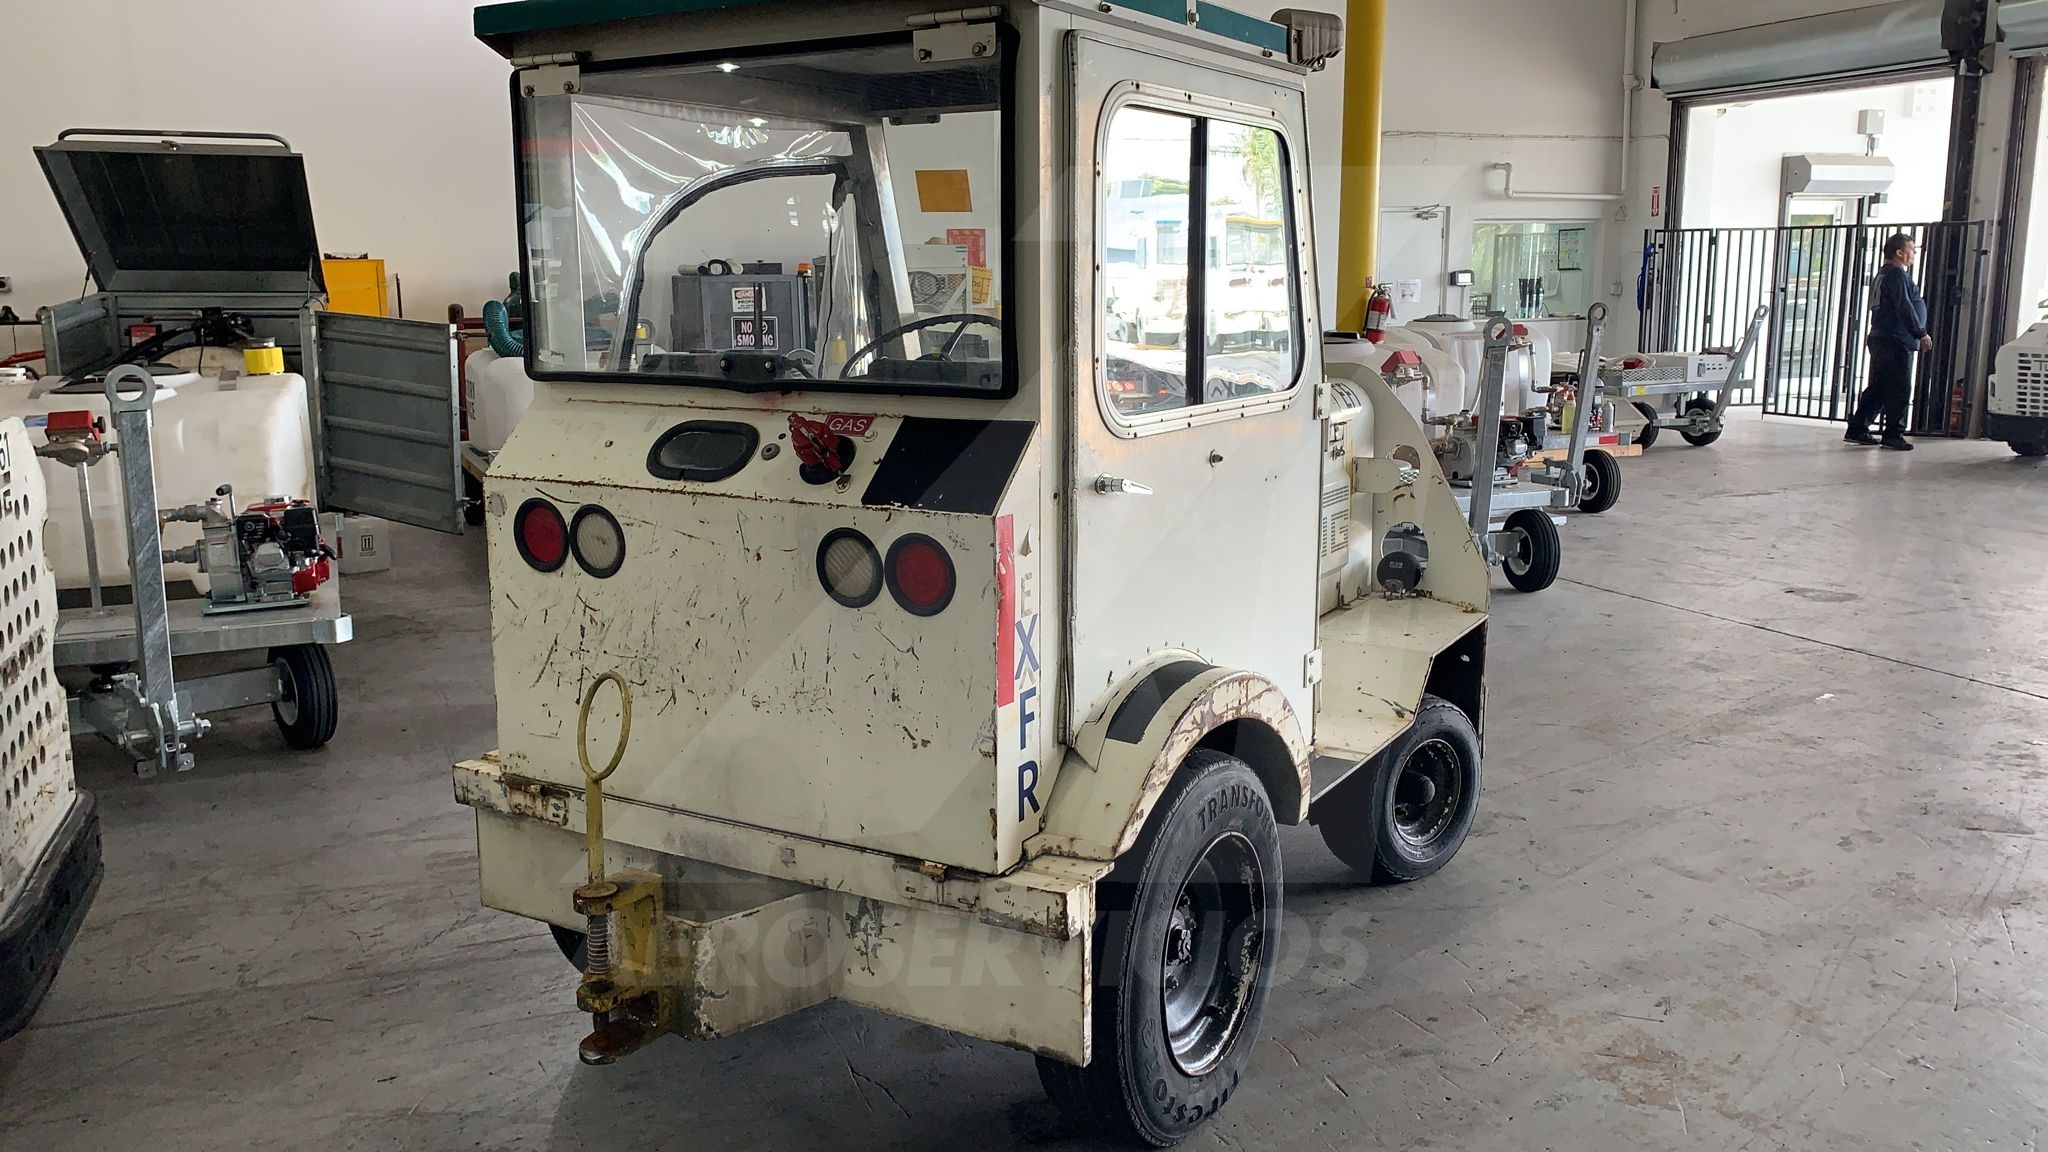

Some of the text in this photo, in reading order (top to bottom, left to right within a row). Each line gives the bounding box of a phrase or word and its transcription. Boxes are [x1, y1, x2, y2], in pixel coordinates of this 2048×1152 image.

[741, 321, 753, 333] NO
[737, 334, 773, 346] SMONG
[829, 418, 867, 432] GAS
